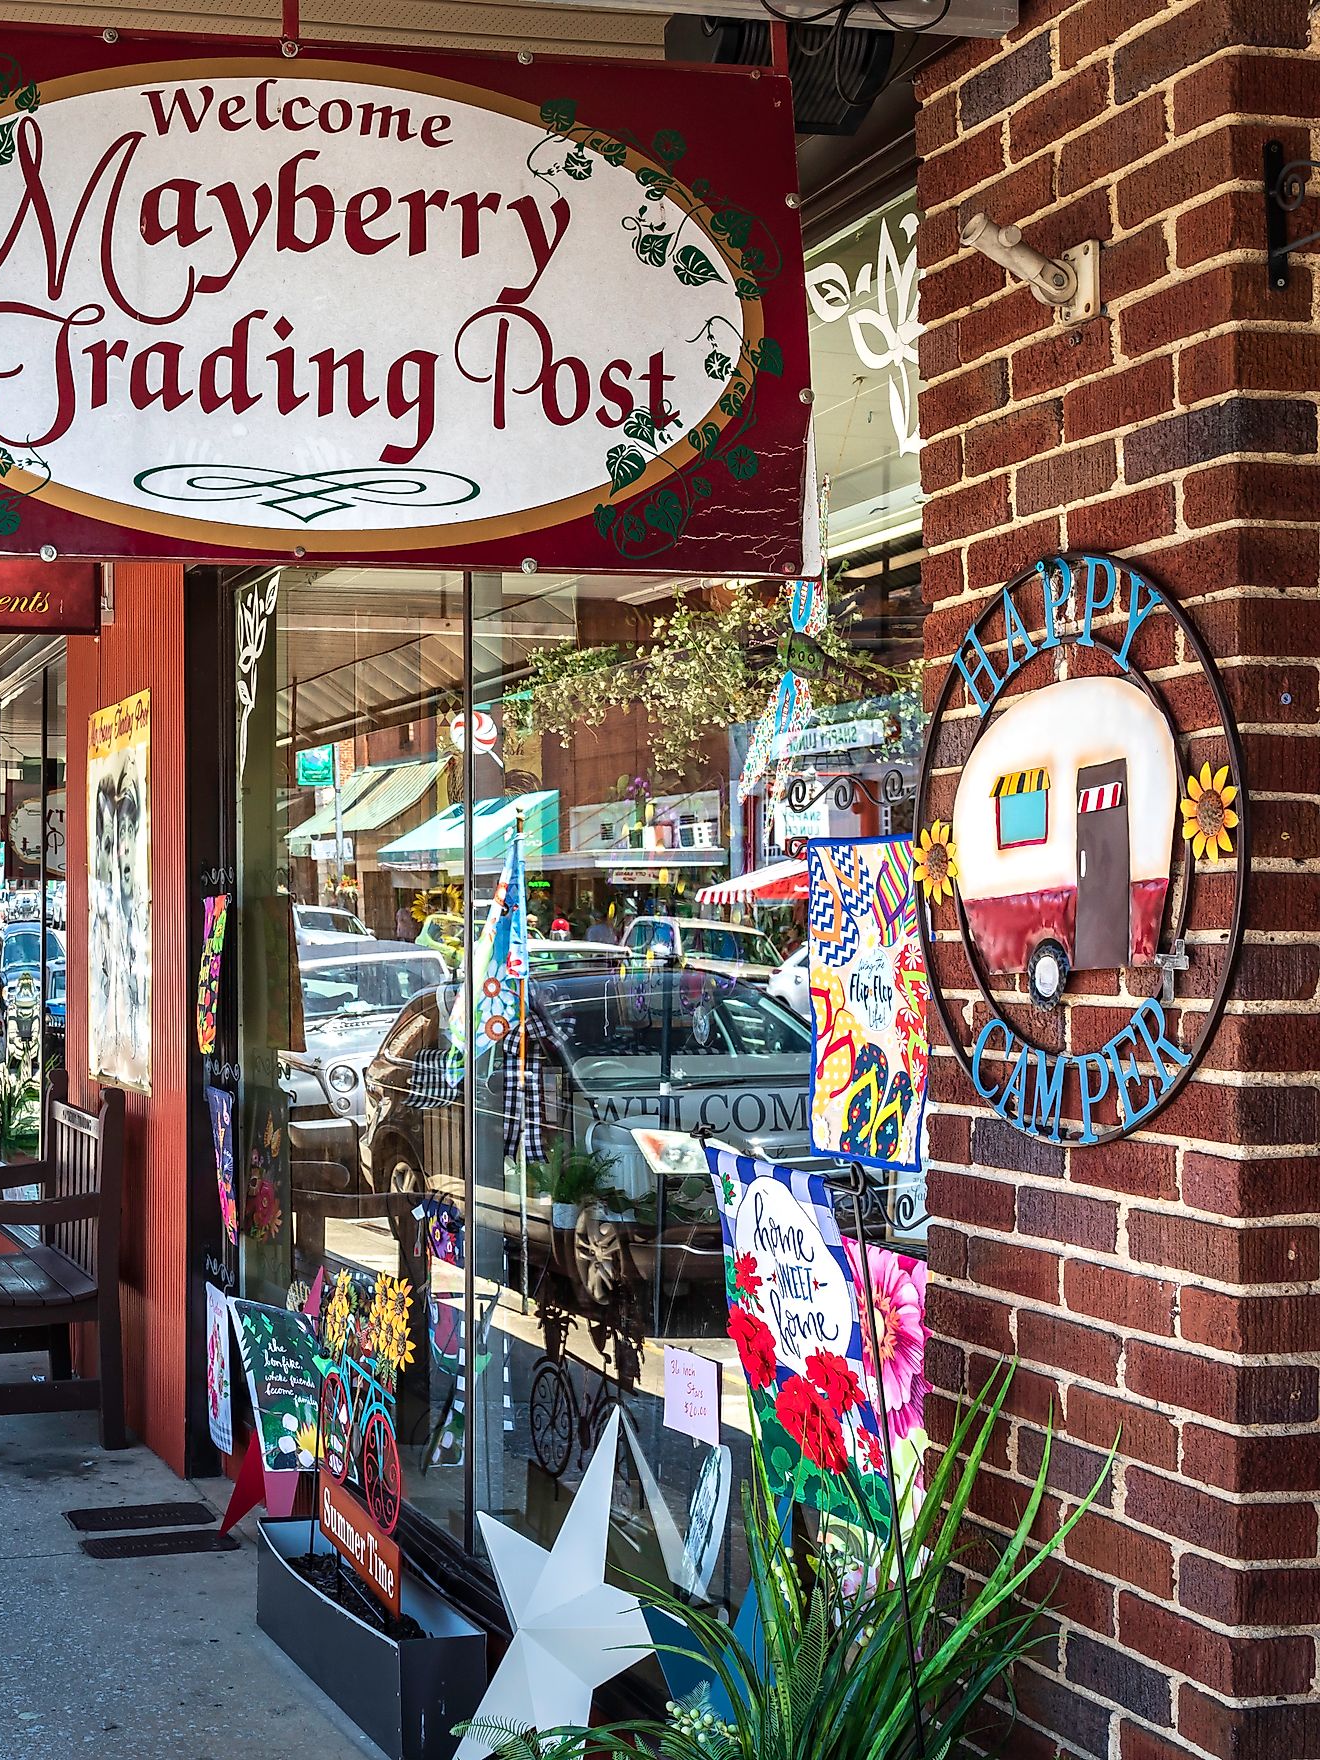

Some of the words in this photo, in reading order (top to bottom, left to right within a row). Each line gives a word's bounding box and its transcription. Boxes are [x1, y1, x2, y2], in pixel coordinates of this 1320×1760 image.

[142, 79, 454, 148] Welcome
[454, 304, 681, 431] Post
[953, 556, 1162, 718] HAPPY
[972, 998, 1192, 1145] CAMPER
[583, 1092, 811, 1134] WELCOM
[754, 1191, 815, 1263] home
[267, 1337, 288, 1353] the
[770, 1288, 839, 1360] home
[264, 1370, 288, 1383] where
[289, 1374, 316, 1389] friends
[264, 1382, 295, 1396] become
[670, 1359, 680, 1375] 36
[682, 1363, 696, 1377] inch
[293, 1394, 319, 1412] family
[683, 1401, 707, 1418] $20.00
[686, 1381, 704, 1399] Stars
[323, 1486, 366, 1566] Summer
[366, 1531, 394, 1599] Time
